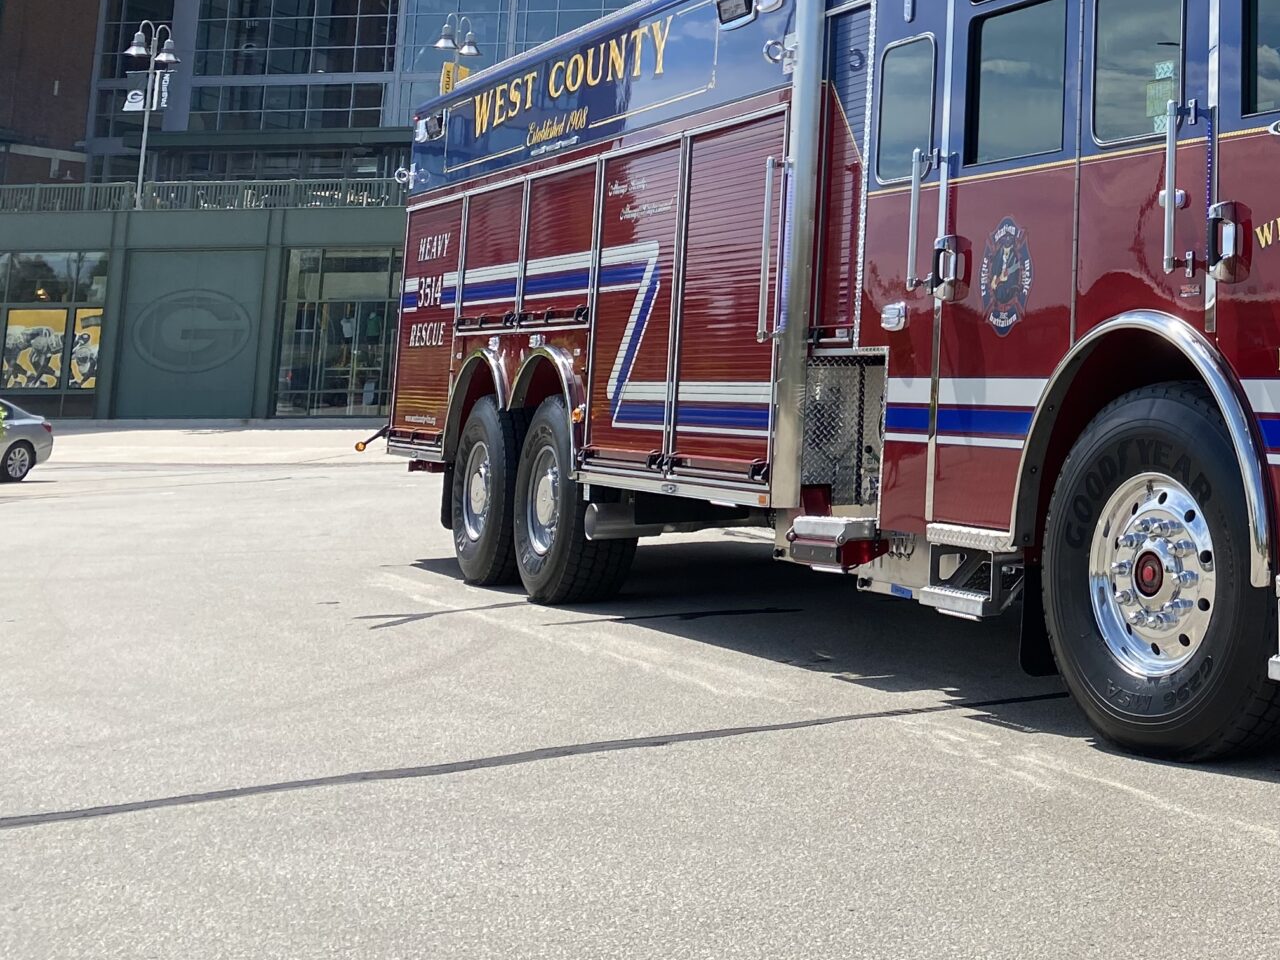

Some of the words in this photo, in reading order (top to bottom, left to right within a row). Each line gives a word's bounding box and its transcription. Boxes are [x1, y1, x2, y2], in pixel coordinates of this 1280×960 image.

[474, 71, 538, 138] WEST
[549, 15, 674, 98] COUNTY
[566, 106, 589, 133] 1908
[417, 232, 451, 262] HEAVY
[417, 275, 443, 308] 3514
[409, 321, 446, 347] RESCUE
